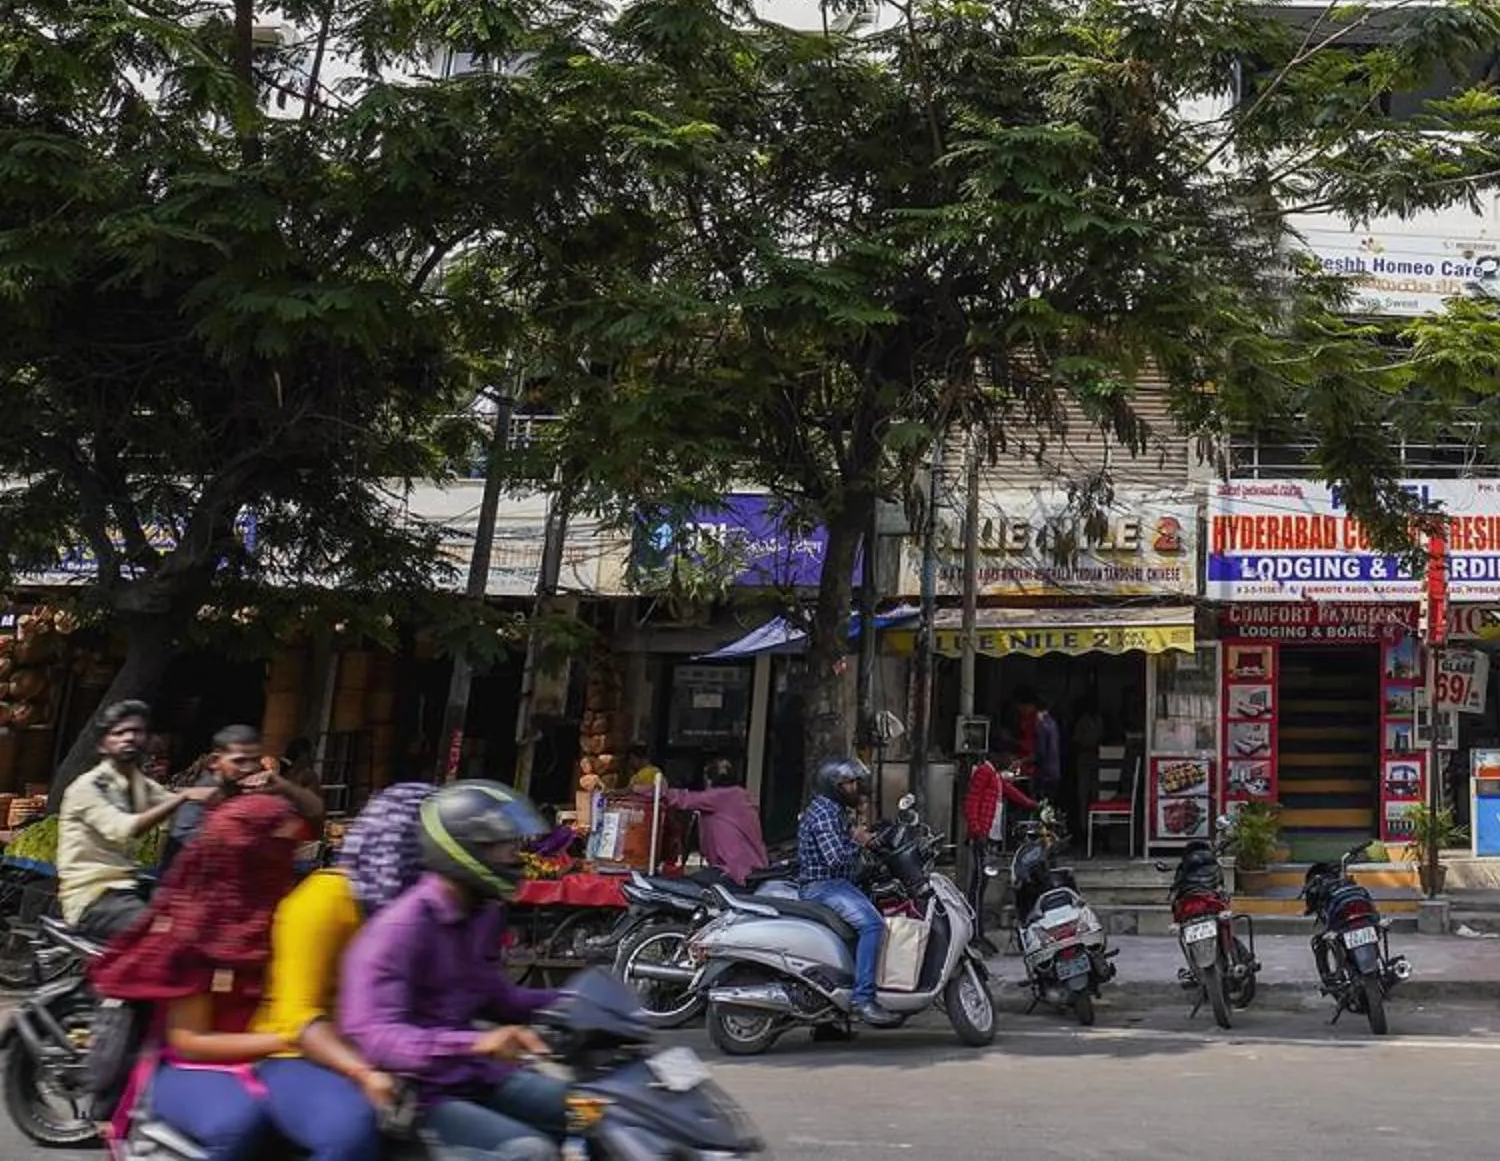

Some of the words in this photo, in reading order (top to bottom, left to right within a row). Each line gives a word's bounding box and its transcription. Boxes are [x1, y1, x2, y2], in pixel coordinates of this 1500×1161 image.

[1373, 257, 1435, 276] Homeo
[1441, 258, 1485, 278] Care
[1153, 517, 1183, 552] 2
[1213, 515, 1337, 551] HYDERABAD
[1241, 557, 1361, 580] LODGING
[1369, 558, 1388, 579] &
[1230, 606, 1313, 624] COMFORT
[1009, 631, 1078, 650] NILE
[1091, 631, 1110, 650] 2
[1239, 626, 1307, 638] LODGING
[1311, 626, 1323, 638] &
